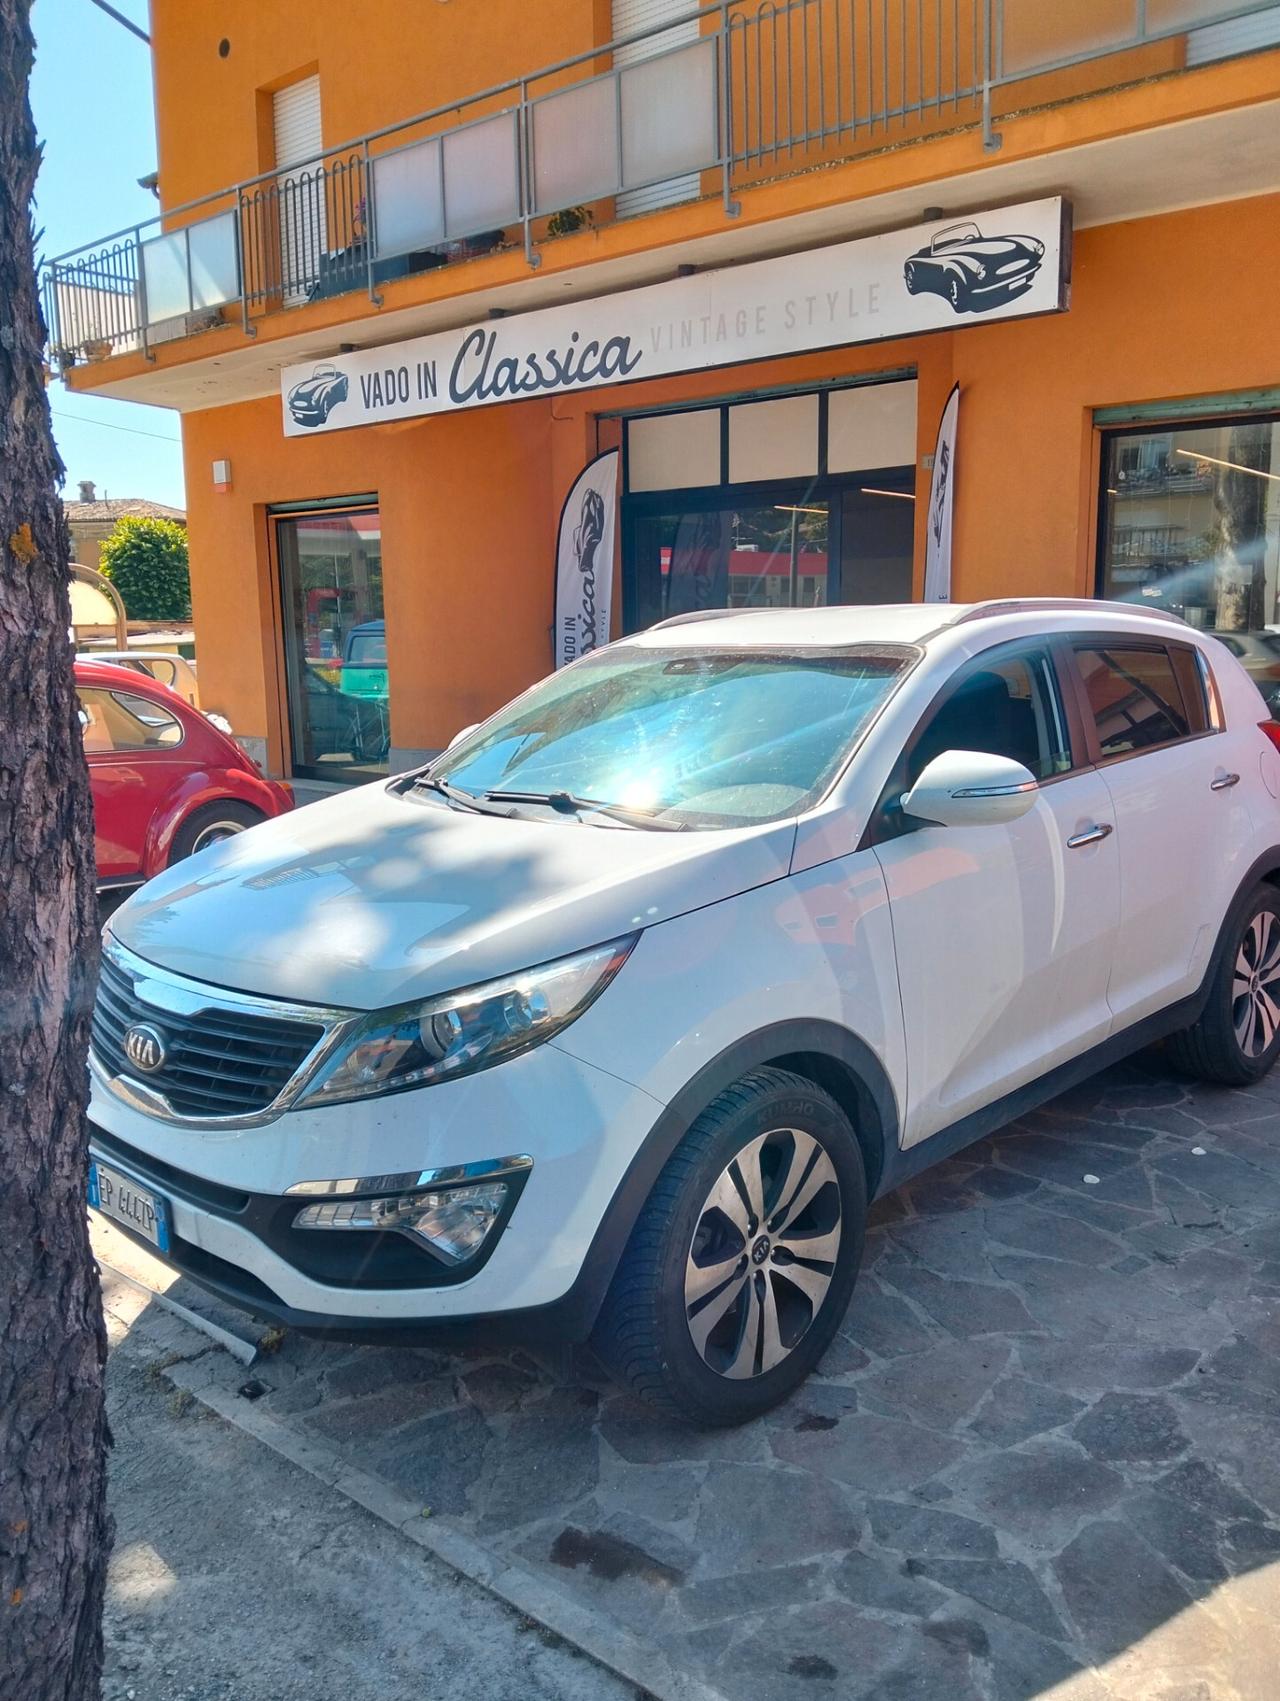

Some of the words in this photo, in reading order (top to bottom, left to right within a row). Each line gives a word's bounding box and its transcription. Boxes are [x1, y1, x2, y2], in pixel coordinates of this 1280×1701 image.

[650, 305, 767, 354] VINTAGE
[784, 283, 881, 330] STYLE
[360, 365, 410, 410] VADO
[417, 360, 438, 401] IN
[449, 328, 643, 404] Classica
[564, 617, 576, 631] IN
[128, 1031, 155, 1065] KIA
[98, 1171, 113, 1206] EP
[754, 1240, 769, 1262] KIA
